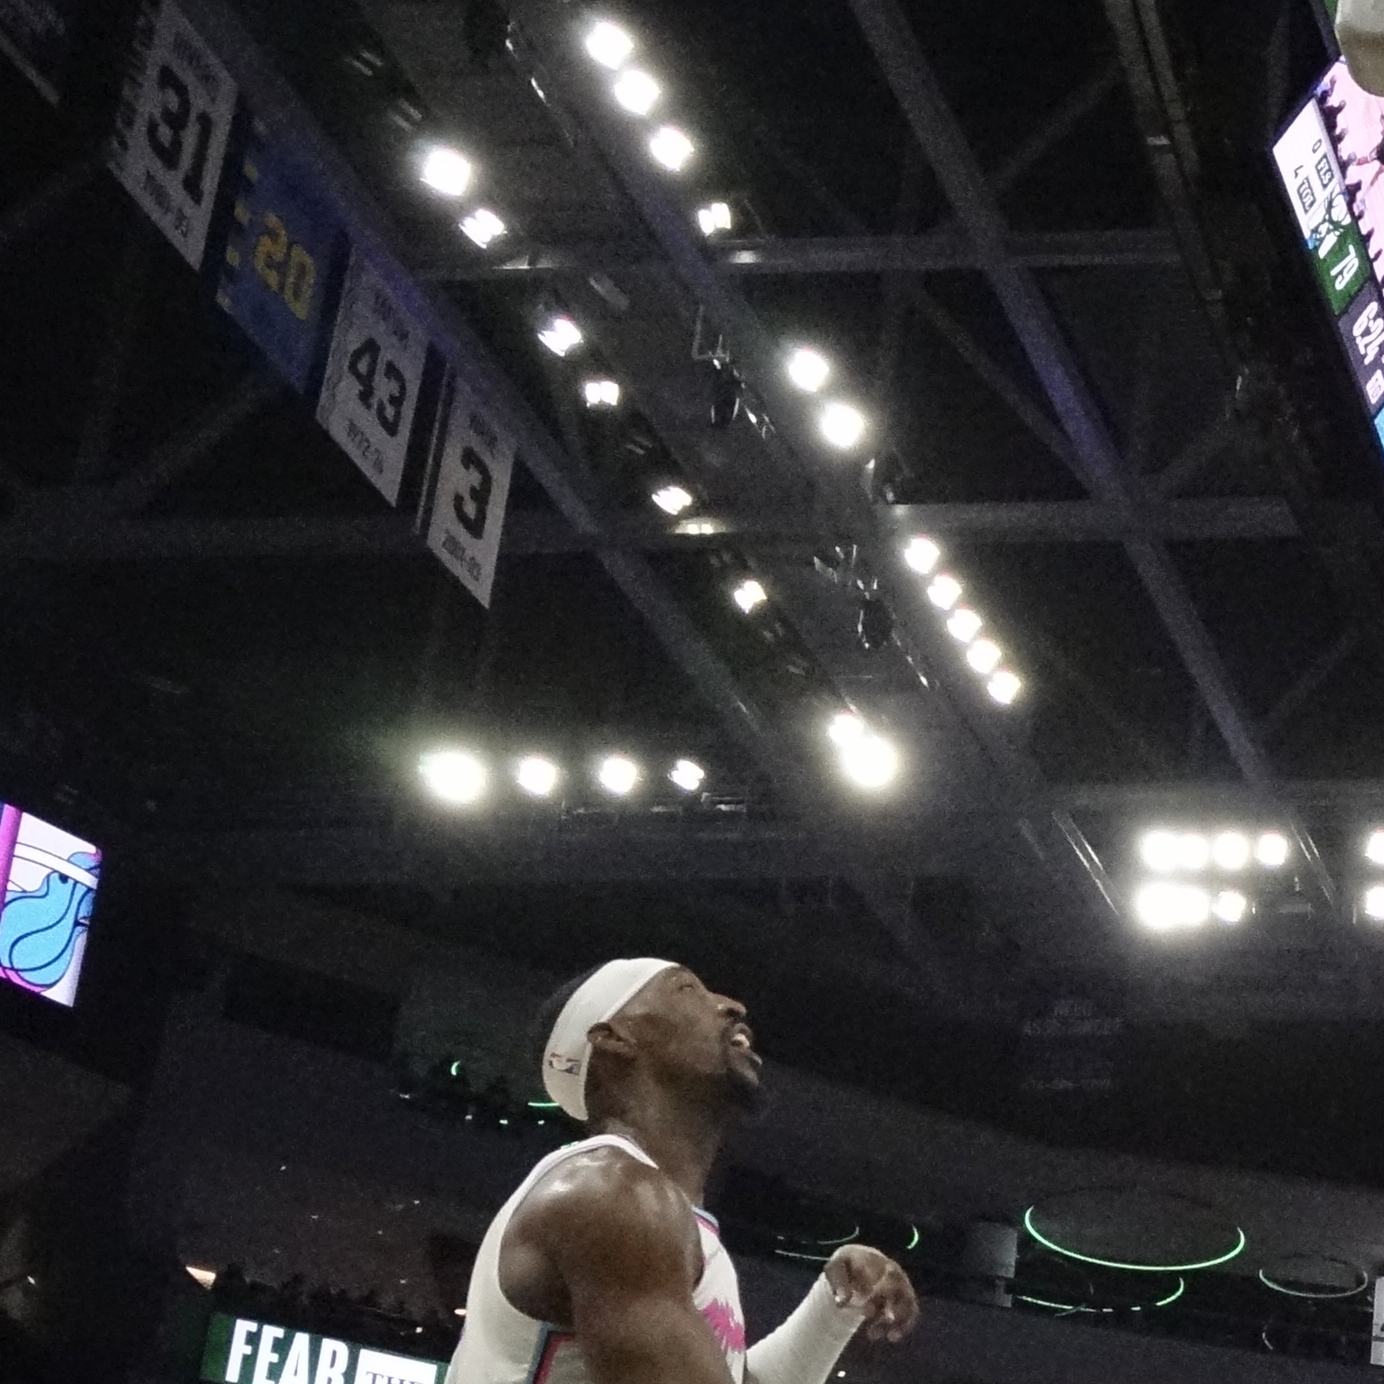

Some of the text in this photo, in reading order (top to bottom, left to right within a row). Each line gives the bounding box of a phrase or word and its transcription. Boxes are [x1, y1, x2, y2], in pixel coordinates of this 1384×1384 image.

[147, 64, 212, 206] 31
[255, 212, 315, 320] 20
[1330, 244, 1359, 290] 79
[349, 338, 406, 437] 43
[454, 446, 492, 539] 3
